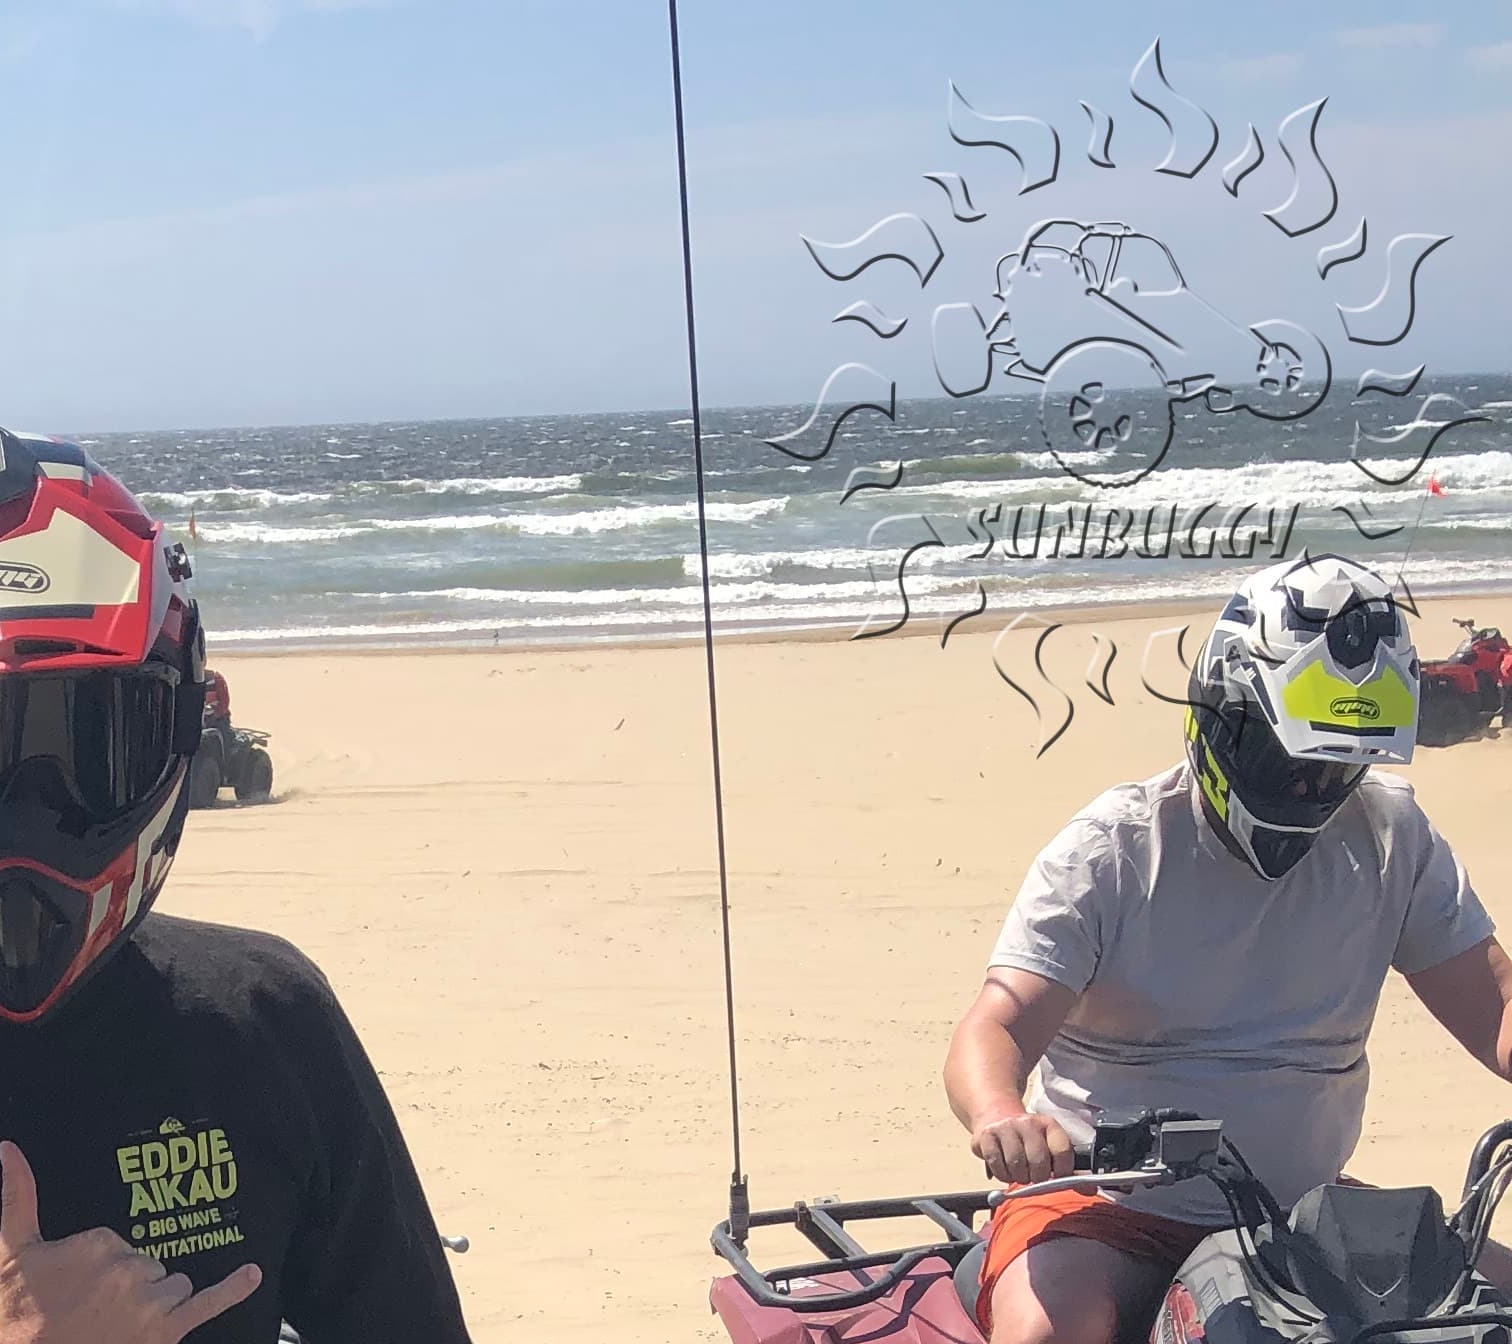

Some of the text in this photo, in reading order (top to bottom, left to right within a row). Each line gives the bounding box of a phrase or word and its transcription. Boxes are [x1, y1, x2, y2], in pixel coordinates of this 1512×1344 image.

[116, 1128, 234, 1184] EDDIE
[129, 1160, 238, 1217] AIKAU
[135, 1225, 245, 1261] NVITATIONAL
[148, 1207, 222, 1238] BIG WAVE
